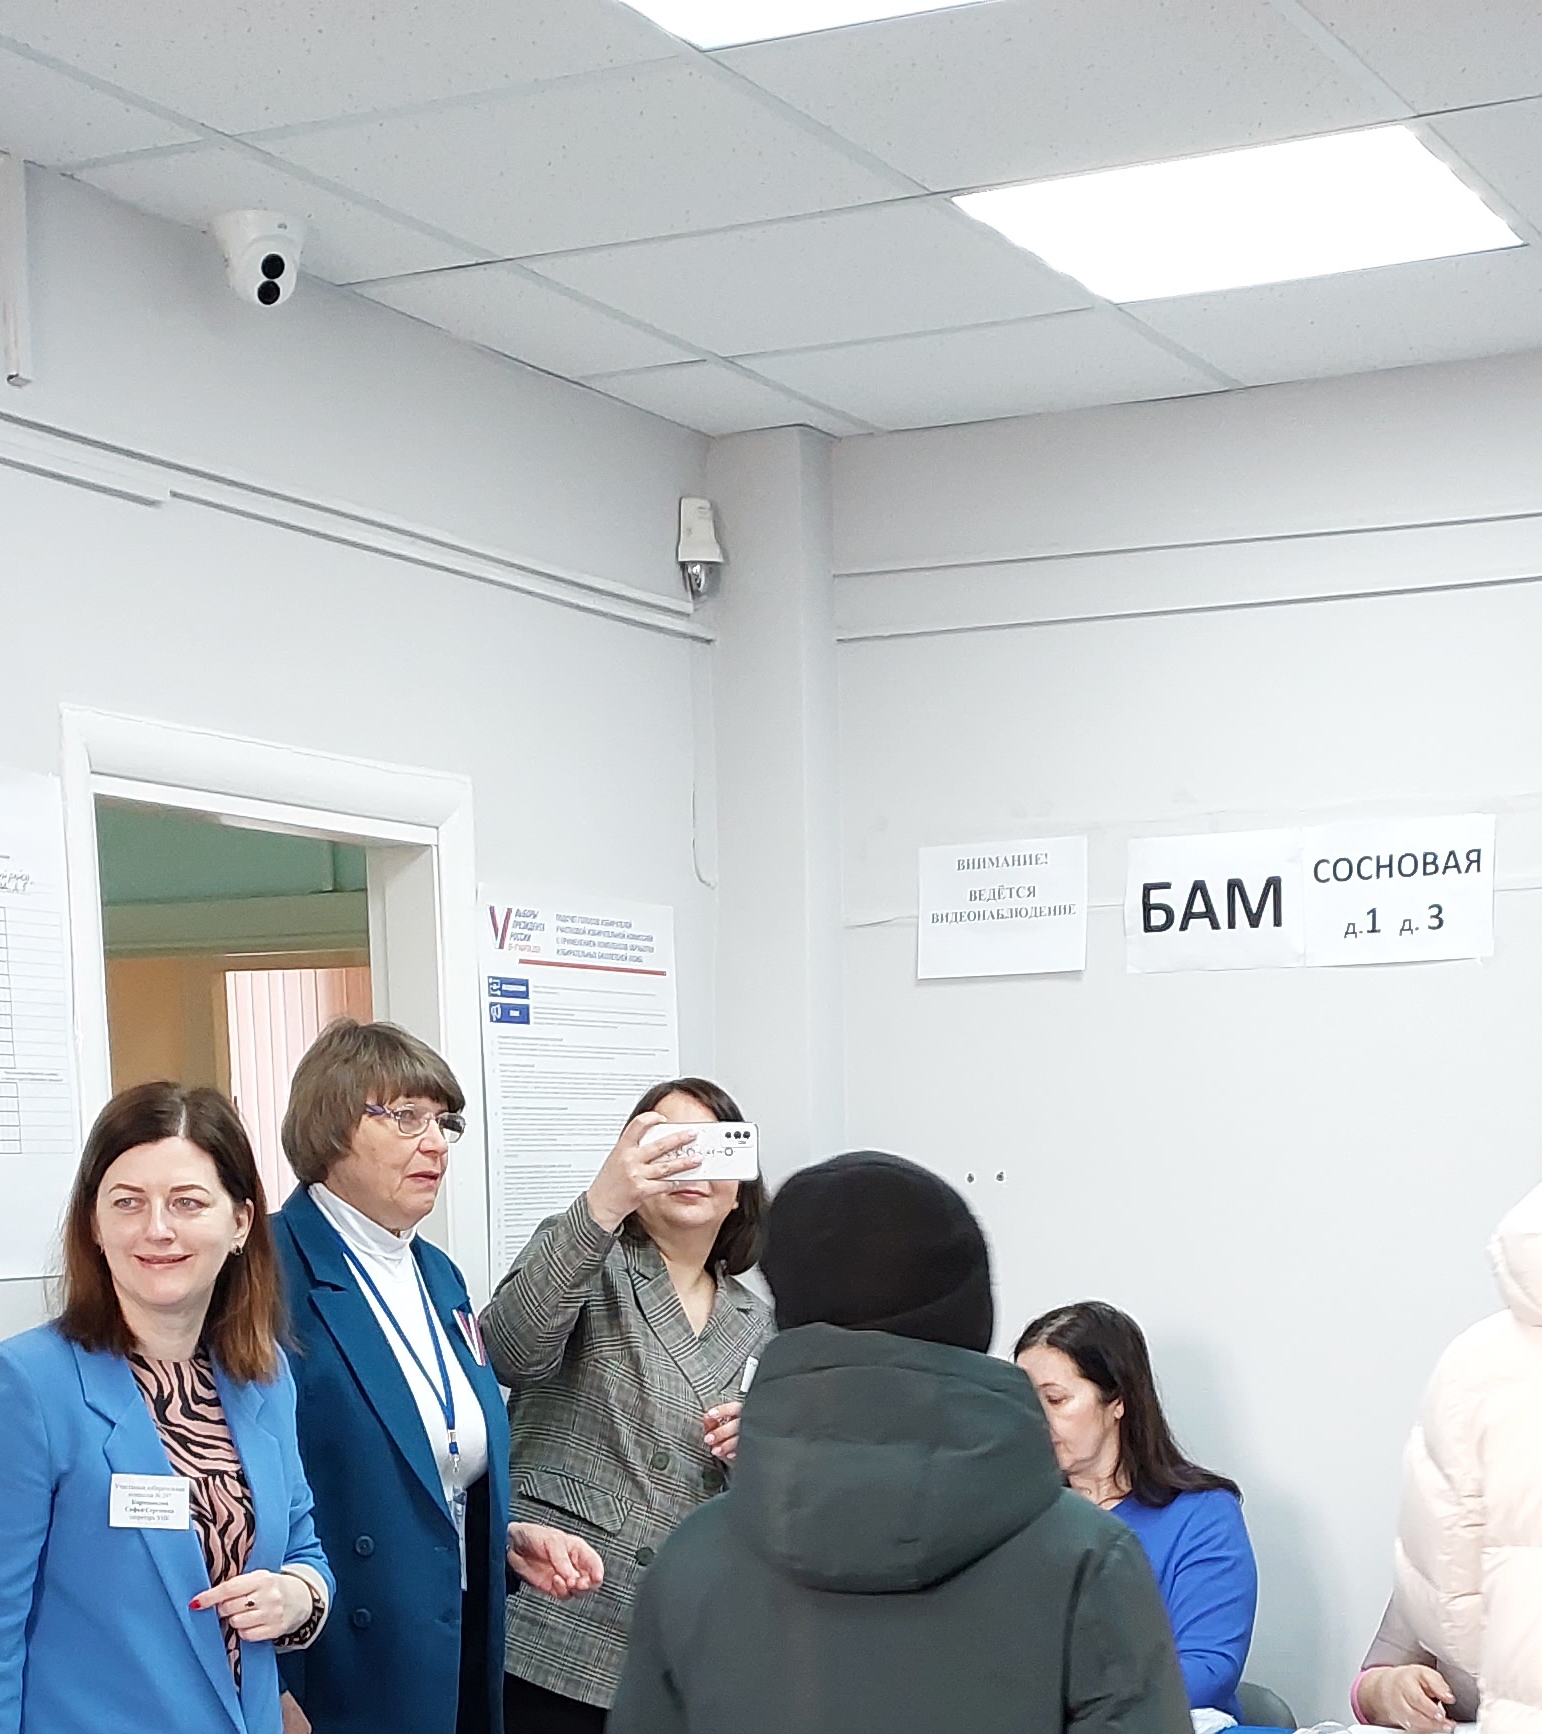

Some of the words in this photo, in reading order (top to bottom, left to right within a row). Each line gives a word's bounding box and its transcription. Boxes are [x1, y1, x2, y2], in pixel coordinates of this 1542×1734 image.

[957, 852, 1049, 871] ВНИМАНИЕ!
[1313, 848, 1483, 884] СОСНОВАЯ
[969, 885, 1036, 902] ВЕДЁТСЯ
[1142, 875, 1283, 934] БАМ
[931, 904, 1077, 925] ВИДЕОНАБЛЮДЕНИЕ
[1344, 907, 1381, 938] д.1
[1399, 918, 1420, 936] д.
[1427, 903, 1445, 931] 3
